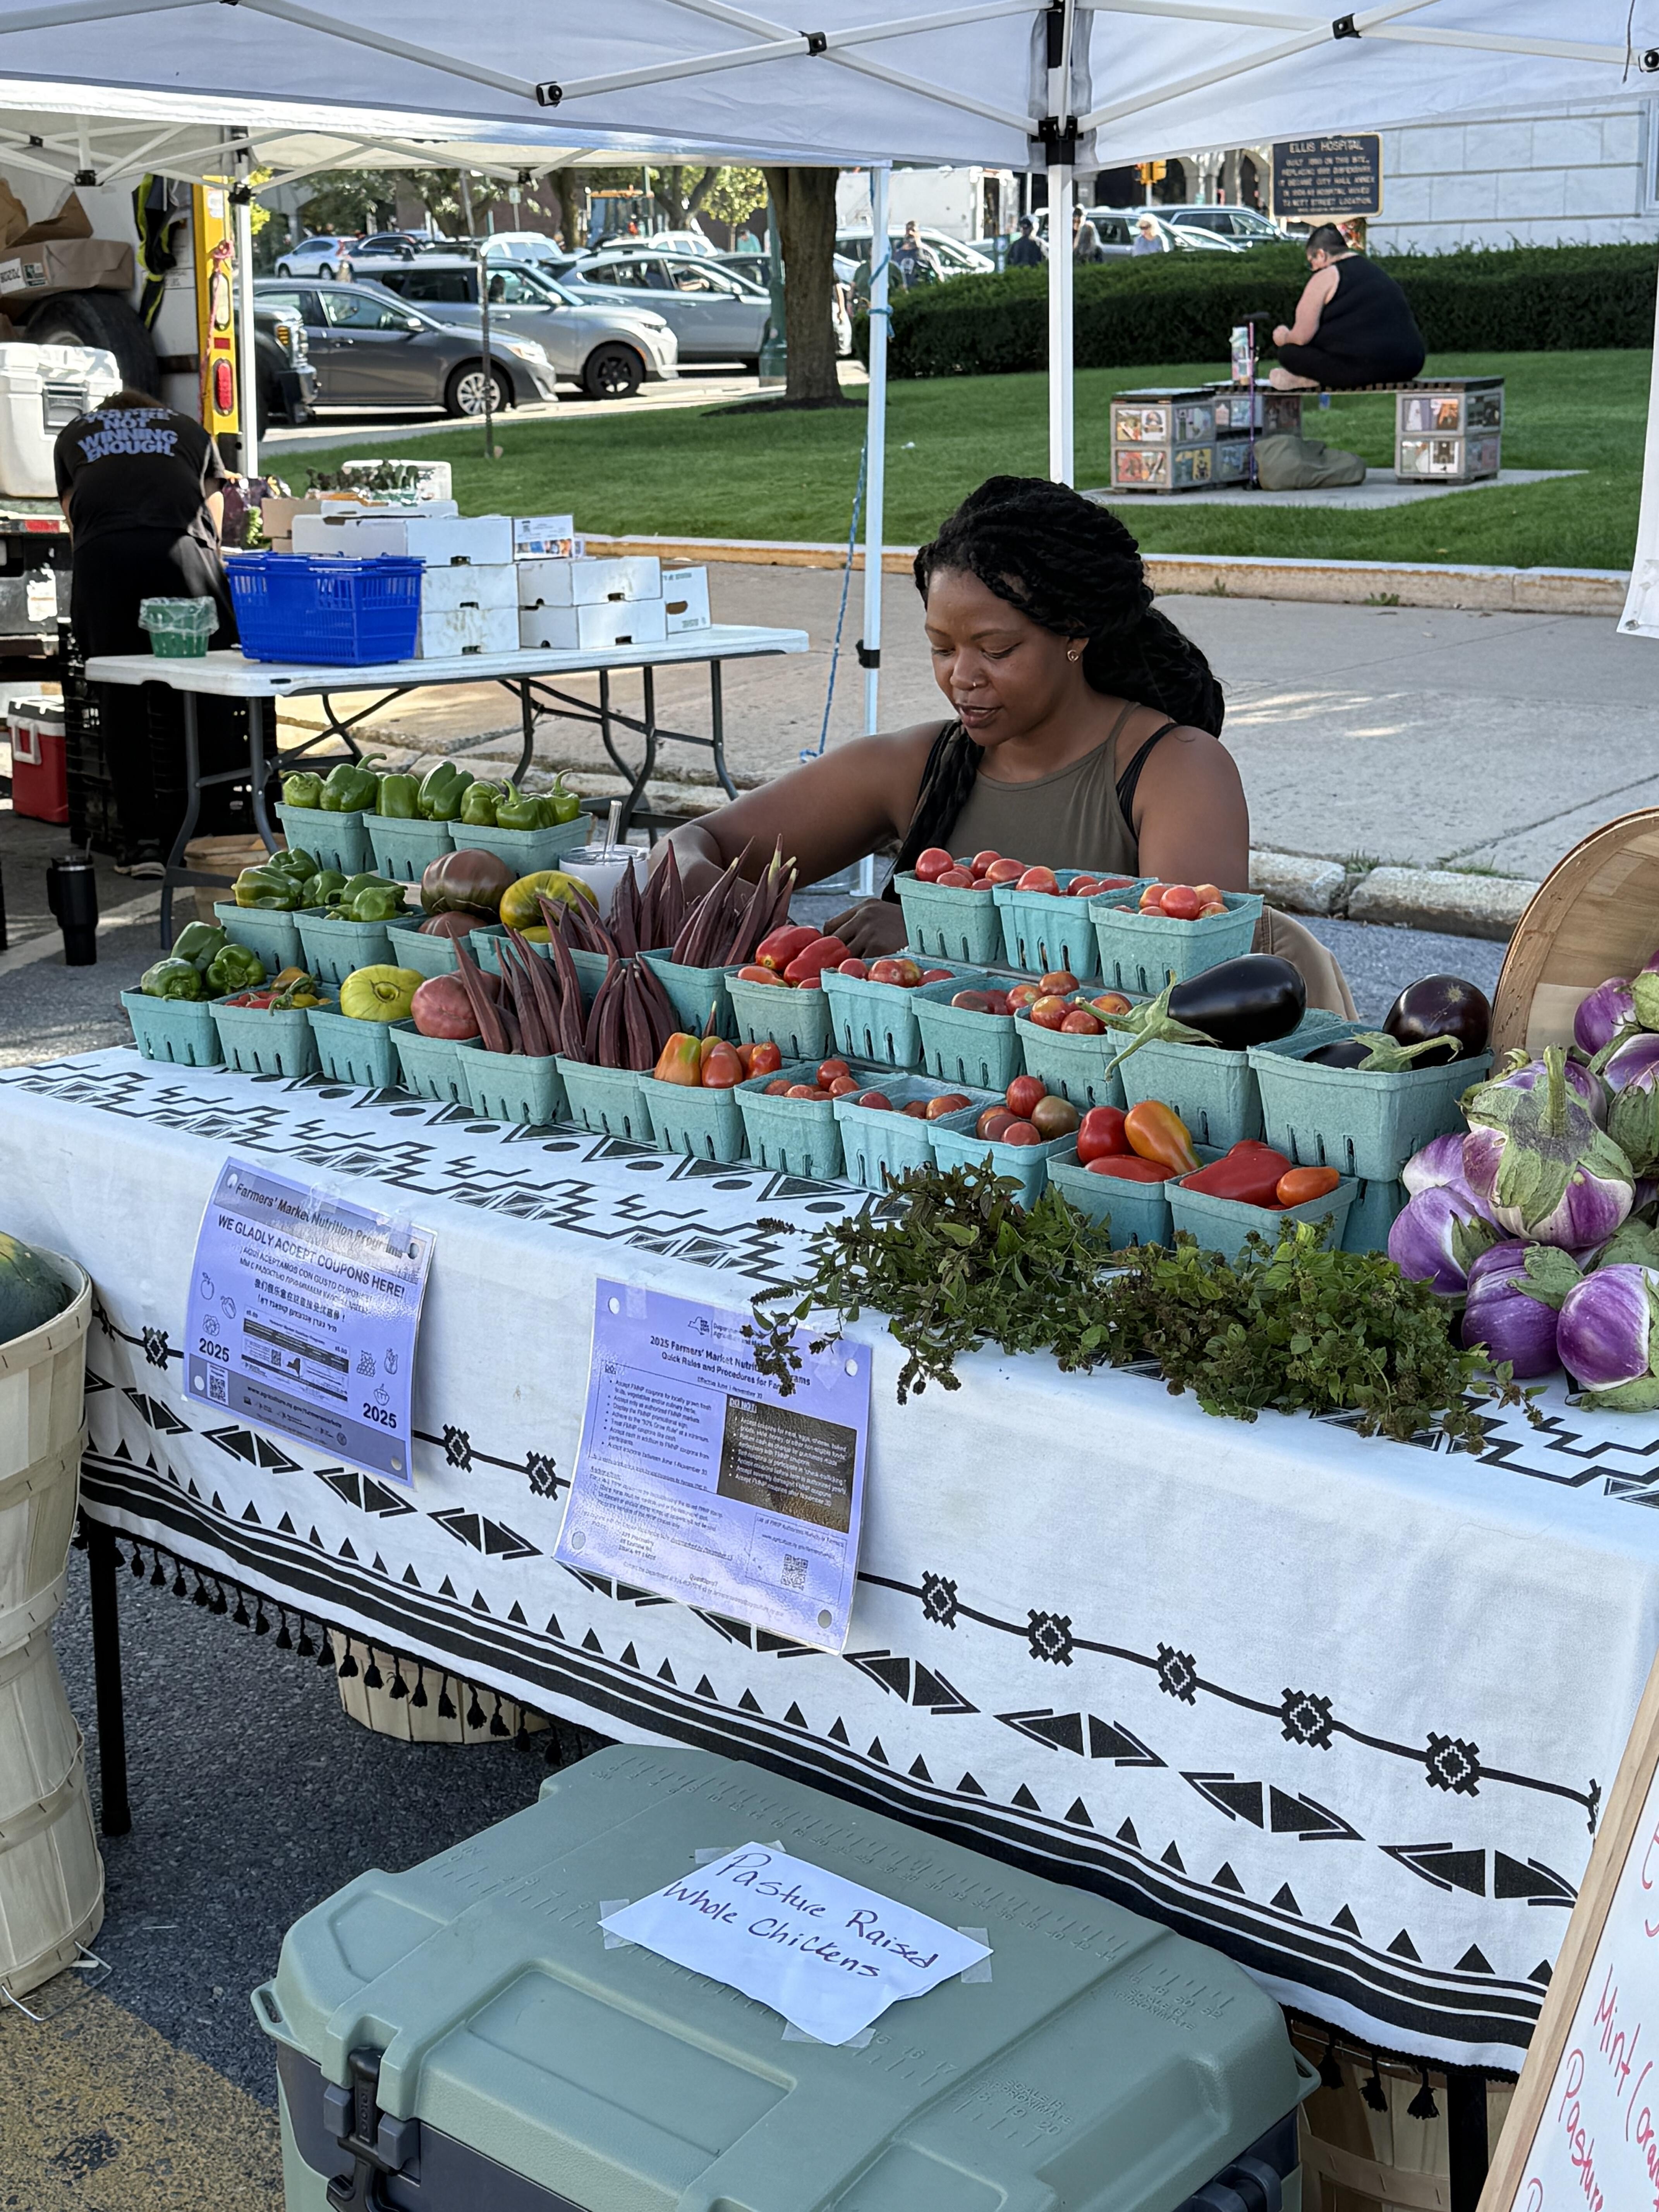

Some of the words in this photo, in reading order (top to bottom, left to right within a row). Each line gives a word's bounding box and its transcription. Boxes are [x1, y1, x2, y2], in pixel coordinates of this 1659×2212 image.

[1289, 142, 1316, 154] ELLIS
[1320, 139, 1364, 151] HOSPITAL
[77, 428, 178, 450] WINNING
[103, 419, 150, 429] NOT
[85, 440, 175, 463] ENOUGH.
[235, 1182, 277, 1209] Farmers'
[311, 1211, 354, 1238] Nutrition
[218, 1214, 234, 1231] WE
[234, 1220, 274, 1247] GLADLY
[274, 1236, 316, 1264] ACCEPT
[317, 1254, 370, 1285] COUPONS
[371, 1275, 405, 1299] HERE!
[259, 1252, 298, 1274] ACEPTAMOS
[298, 1268, 313, 1281] CON
[314, 1274, 336, 1290] GUSTO
[198, 1337, 230, 1363] 2025
[670, 1341, 704, 1357] Farmers'
[705, 1350, 733, 1365] Market
[661, 1351, 681, 1364] Quick
[682, 1357, 701, 1369] Rules
[702, 1362, 716, 1373] and
[716, 1366, 755, 1384] Procedures
[756, 1376, 767, 1387] for
[362, 1401, 398, 1430] 2025
[663, 1881, 738, 1924] Whole
[747, 1917, 881, 1978] Chickens
[845, 1909, 939, 1970] Raised
[1174, 1996, 1197, 2008] 50
[1200, 2006, 1224, 2020] 52
[1593, 1963, 1641, 2097] Mint
[1005, 2103, 1027, 2119] 19
[1035, 2120, 1062, 2136] 20
